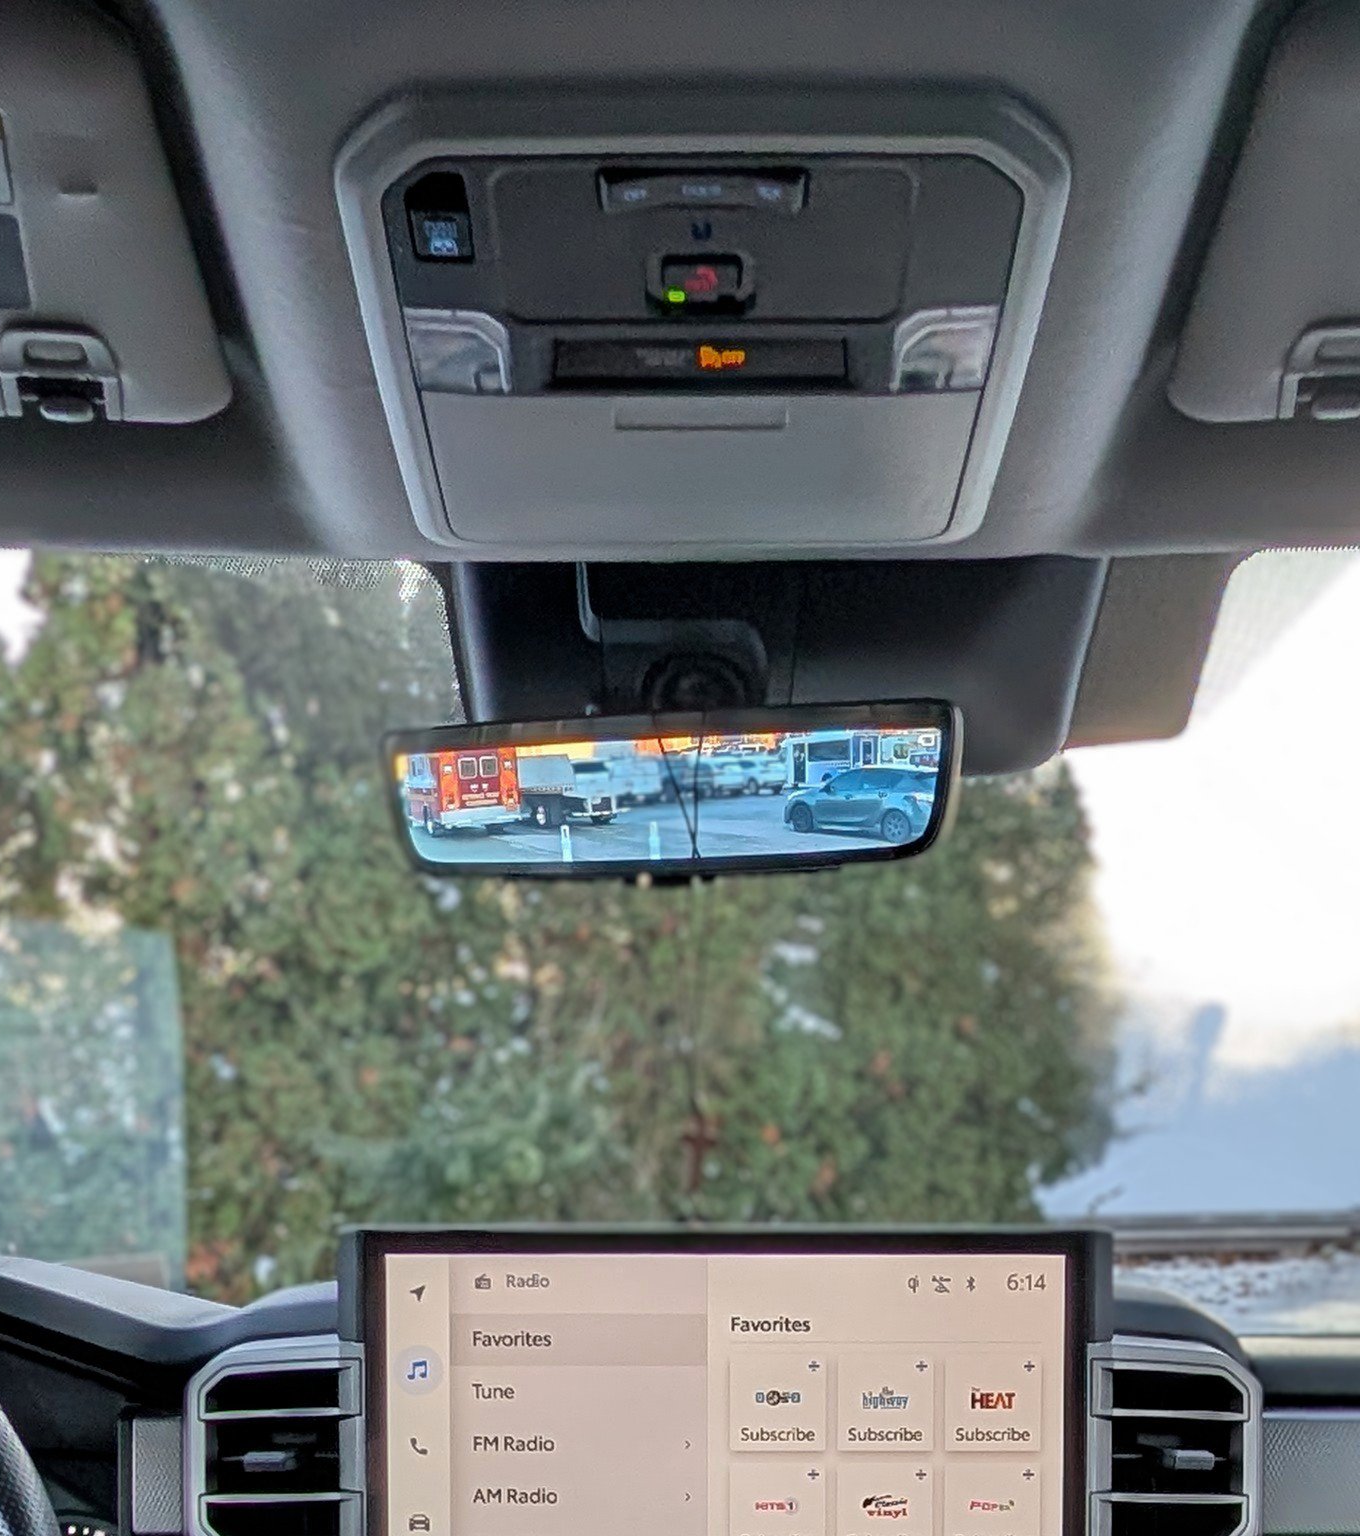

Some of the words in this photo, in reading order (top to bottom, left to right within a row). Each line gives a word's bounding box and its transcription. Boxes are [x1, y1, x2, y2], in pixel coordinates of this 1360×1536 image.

[506, 1274, 550, 1289] Radio
[1007, 1274, 1047, 1291] 6:14
[730, 1316, 811, 1333] Favorites
[472, 1331, 552, 1347] Favorites
[472, 1383, 515, 1399] Tune
[971, 1392, 1016, 1409] HEAT
[741, 1427, 815, 1442] Subscribe
[848, 1427, 923, 1442] Subscribe
[956, 1427, 1030, 1442] Subscribe
[473, 1437, 498, 1451] FM
[504, 1436, 555, 1452] Radio
[473, 1489, 502, 1503] AM
[507, 1488, 558, 1504] Radio
